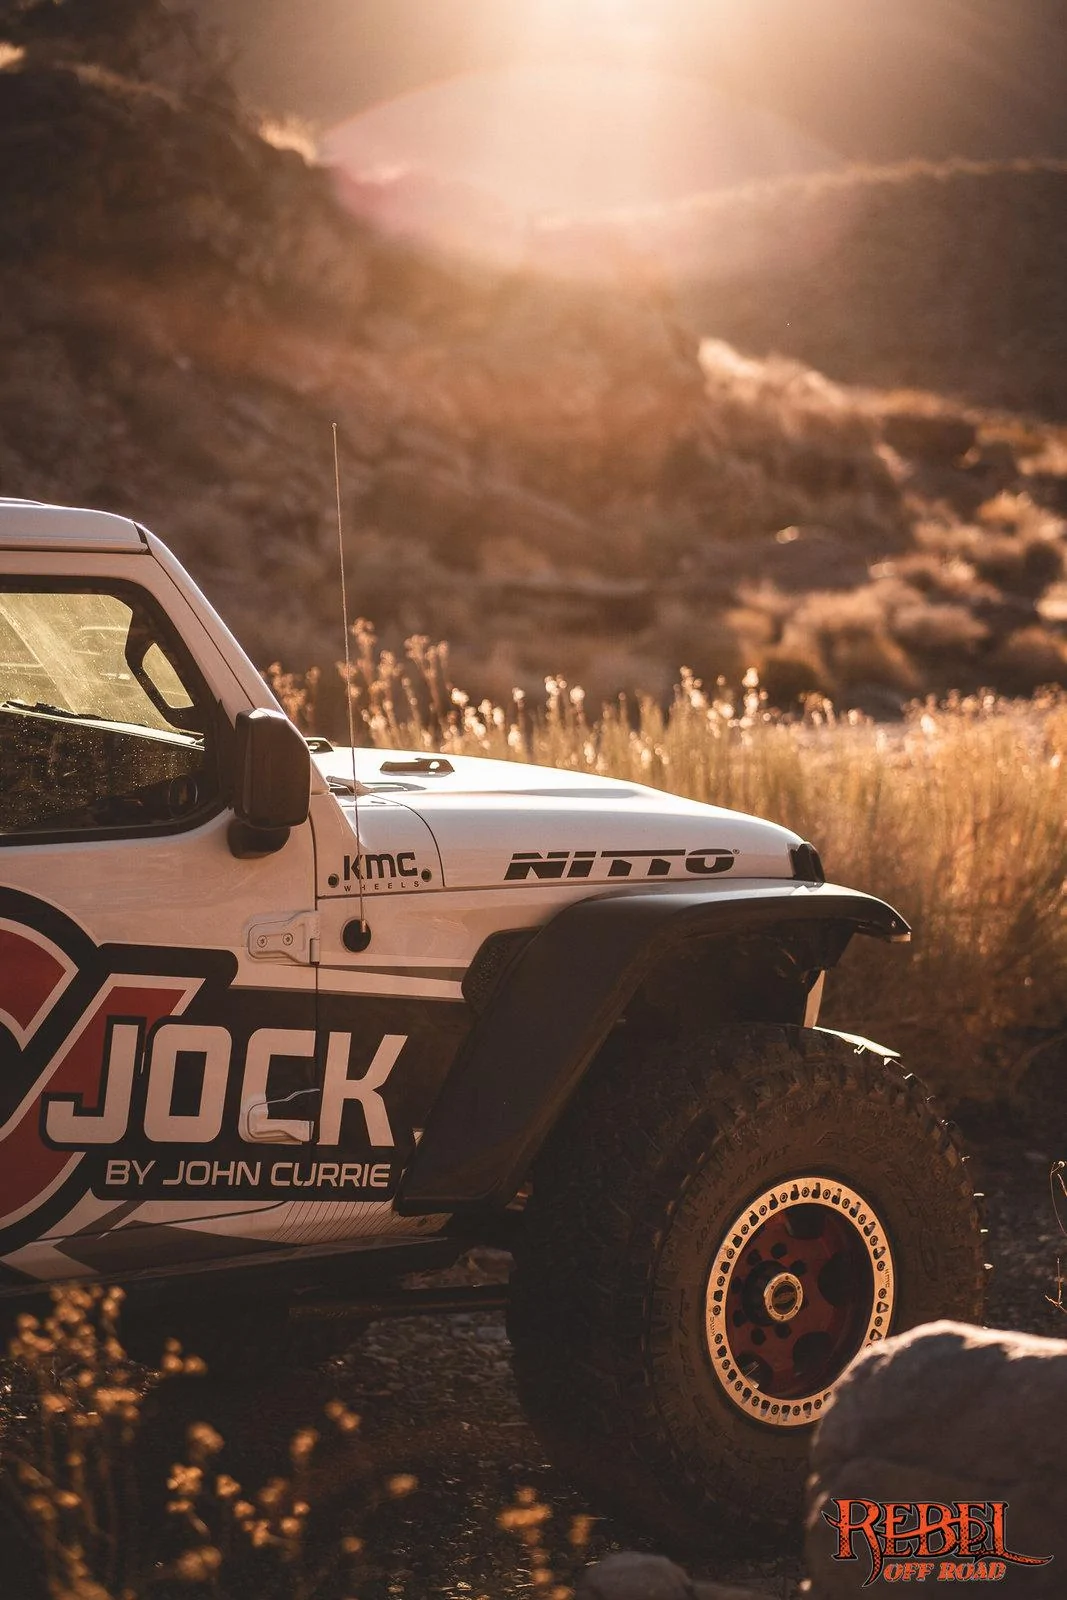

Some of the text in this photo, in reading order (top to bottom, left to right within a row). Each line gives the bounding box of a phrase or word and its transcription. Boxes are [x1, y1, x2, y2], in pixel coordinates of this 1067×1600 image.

[344, 881, 420, 892] WHEELS
[46, 1023, 408, 1147] JOCK
[105, 1159, 392, 1188] BY JOHN CURRIE
